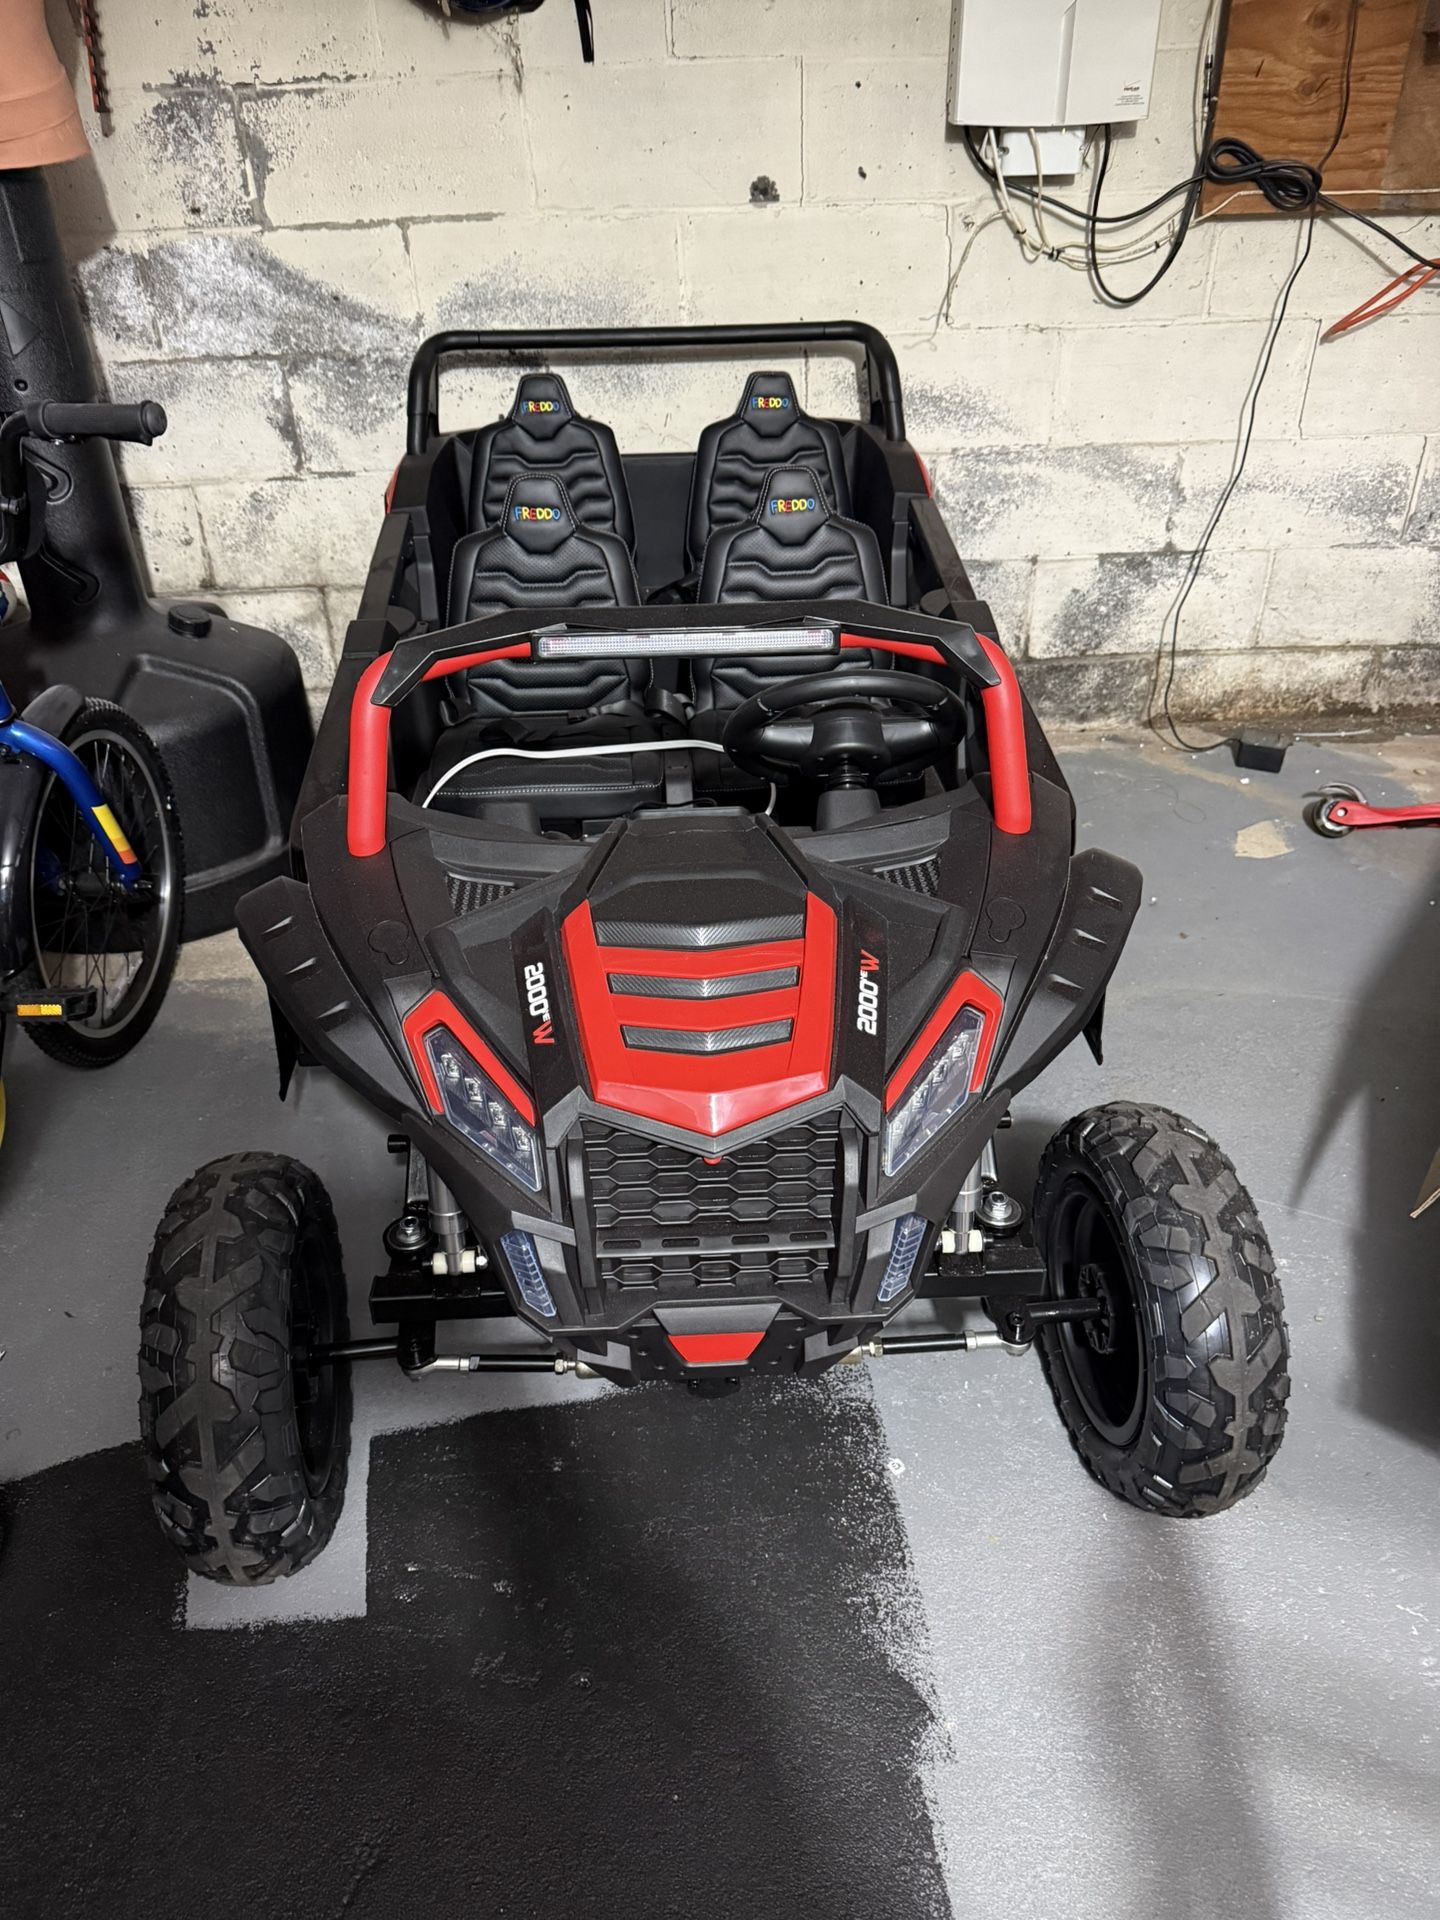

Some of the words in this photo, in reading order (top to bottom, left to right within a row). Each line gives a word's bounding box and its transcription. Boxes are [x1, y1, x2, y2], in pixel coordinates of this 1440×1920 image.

[521, 400, 560, 414] FREDDO
[752, 396, 789, 409] FREDDO
[514, 506, 561, 521] FREDDO
[770, 498, 815, 515] FREDDO
